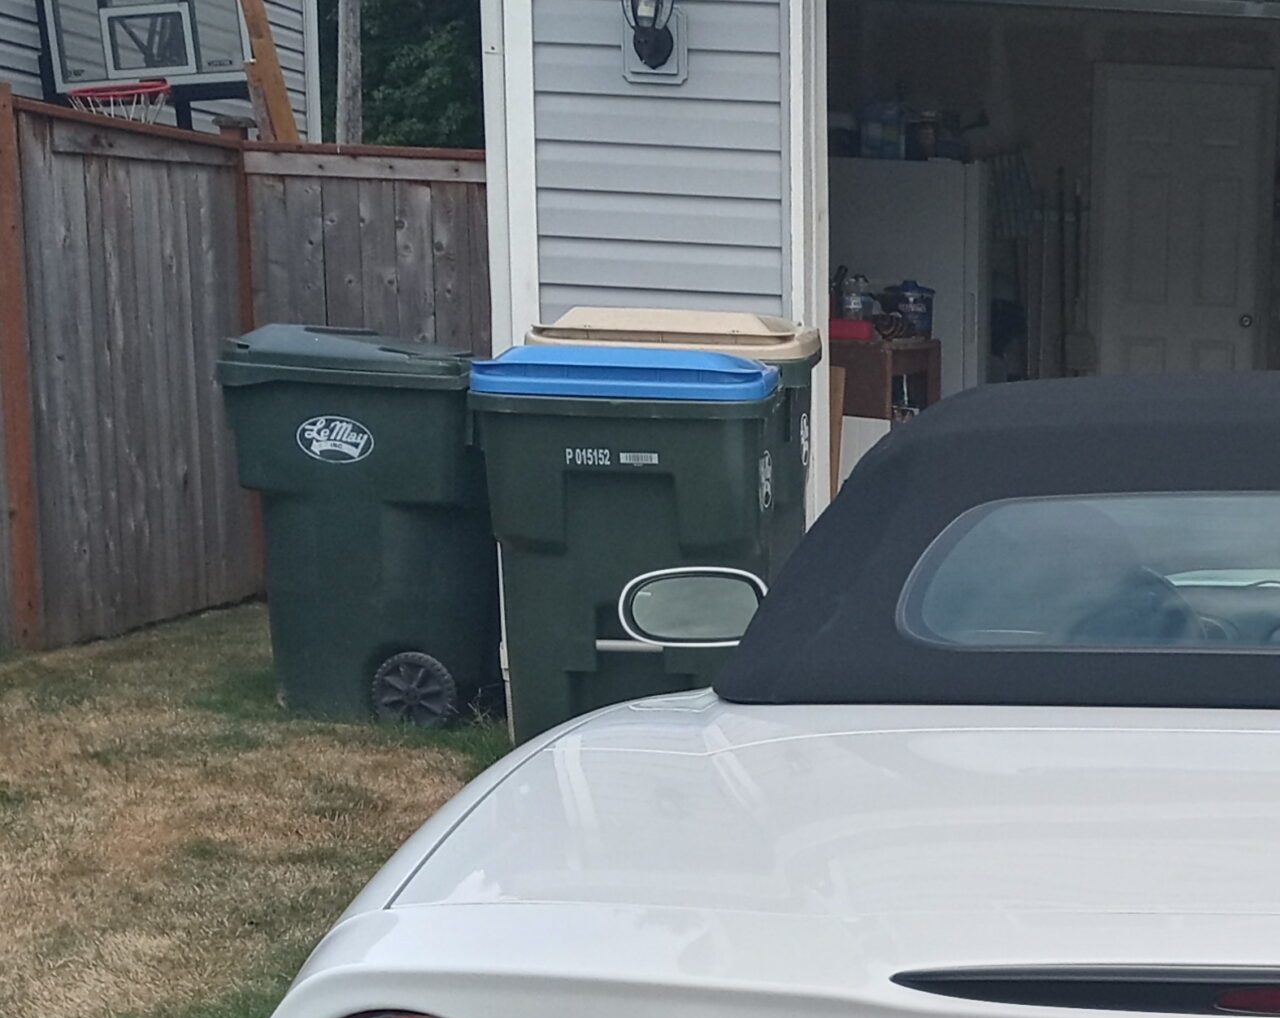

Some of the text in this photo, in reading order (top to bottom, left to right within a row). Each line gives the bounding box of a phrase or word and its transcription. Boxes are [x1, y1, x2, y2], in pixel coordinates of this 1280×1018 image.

[304, 418, 368, 454] LeMay
[565, 448, 611, 465] P 015152
